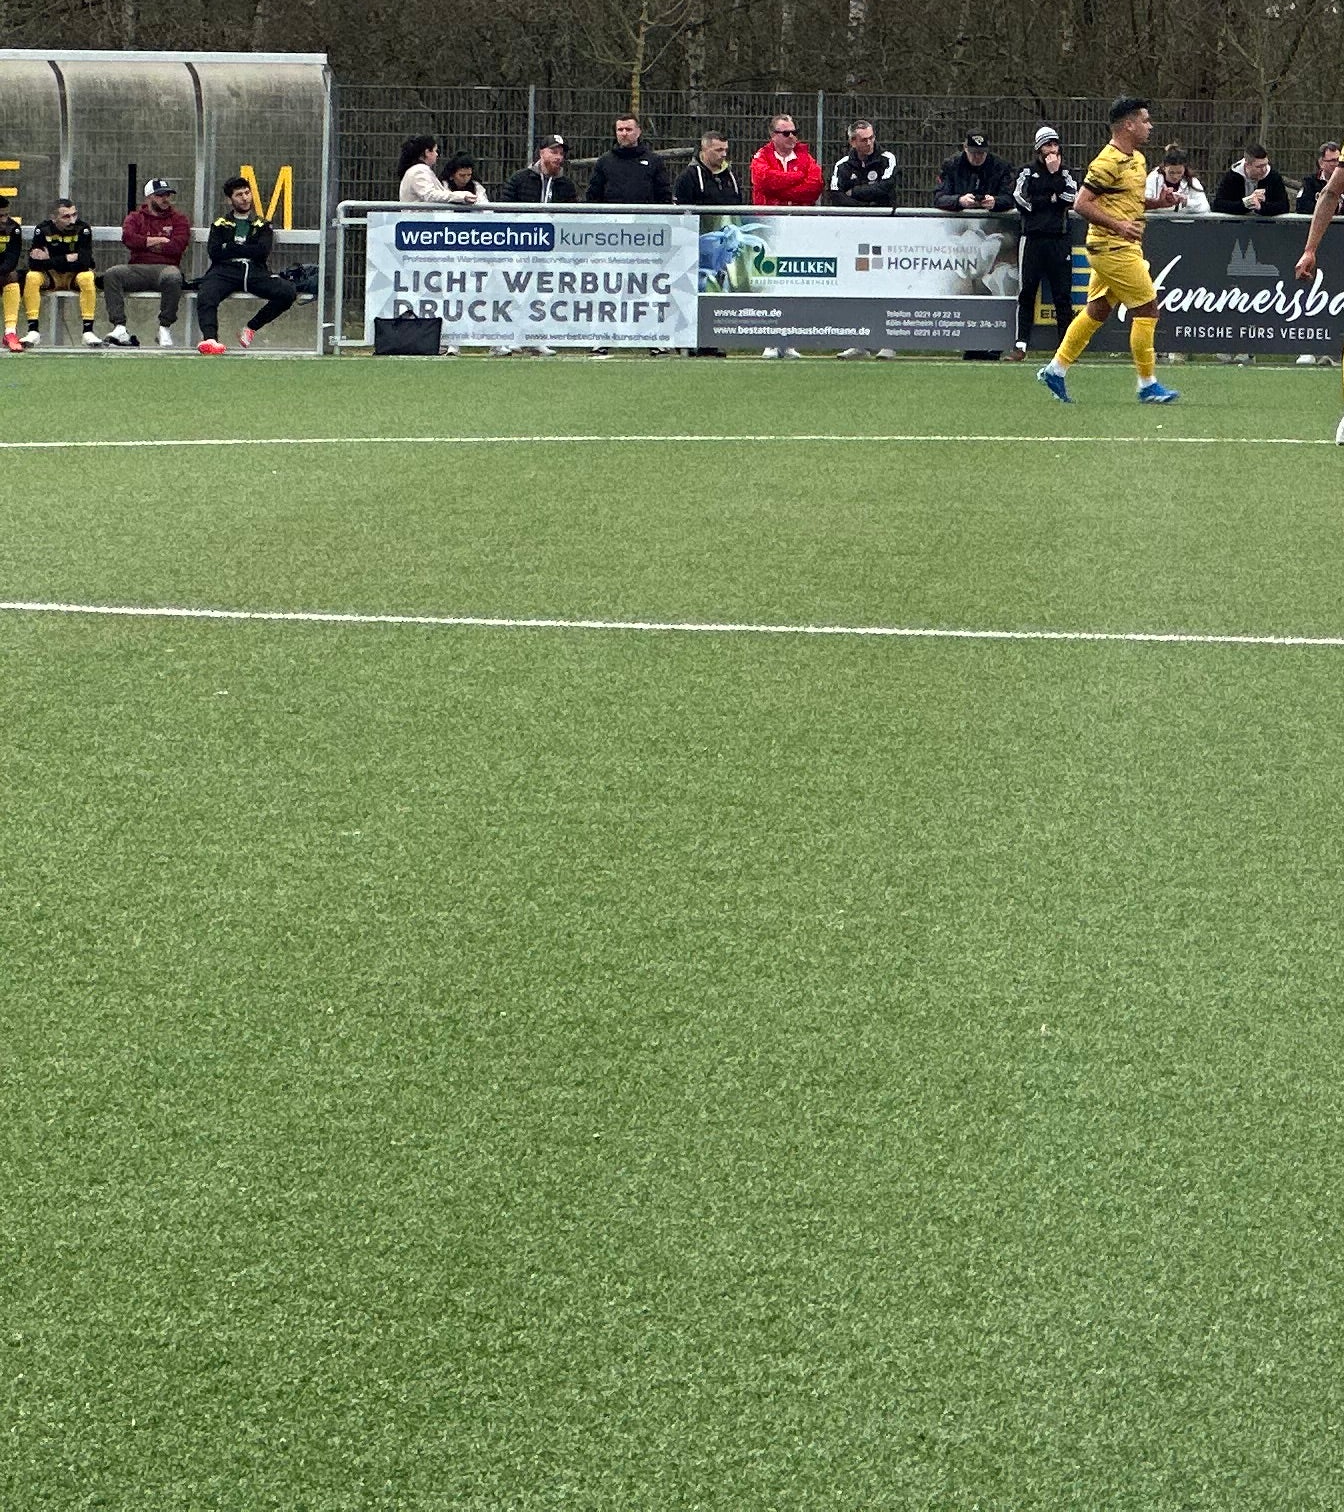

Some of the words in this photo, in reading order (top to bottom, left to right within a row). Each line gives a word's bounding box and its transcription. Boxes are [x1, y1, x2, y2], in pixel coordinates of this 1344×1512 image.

[401, 226, 550, 247] werbetechnik
[560, 228, 665, 247] kurscheid
[778, 260, 836, 274] ZILLKEN
[887, 256, 978, 271] HOFFMANN
[394, 270, 489, 293] LICHT
[503, 271, 672, 294] WERBUNG
[393, 299, 513, 323] DRUCK
[528, 299, 671, 324] SCHRIFT
[1176, 326, 1233, 338] FRISCHE
[1239, 324, 1275, 339] FÜRS
[1280, 327, 1332, 340] VEEDEL
